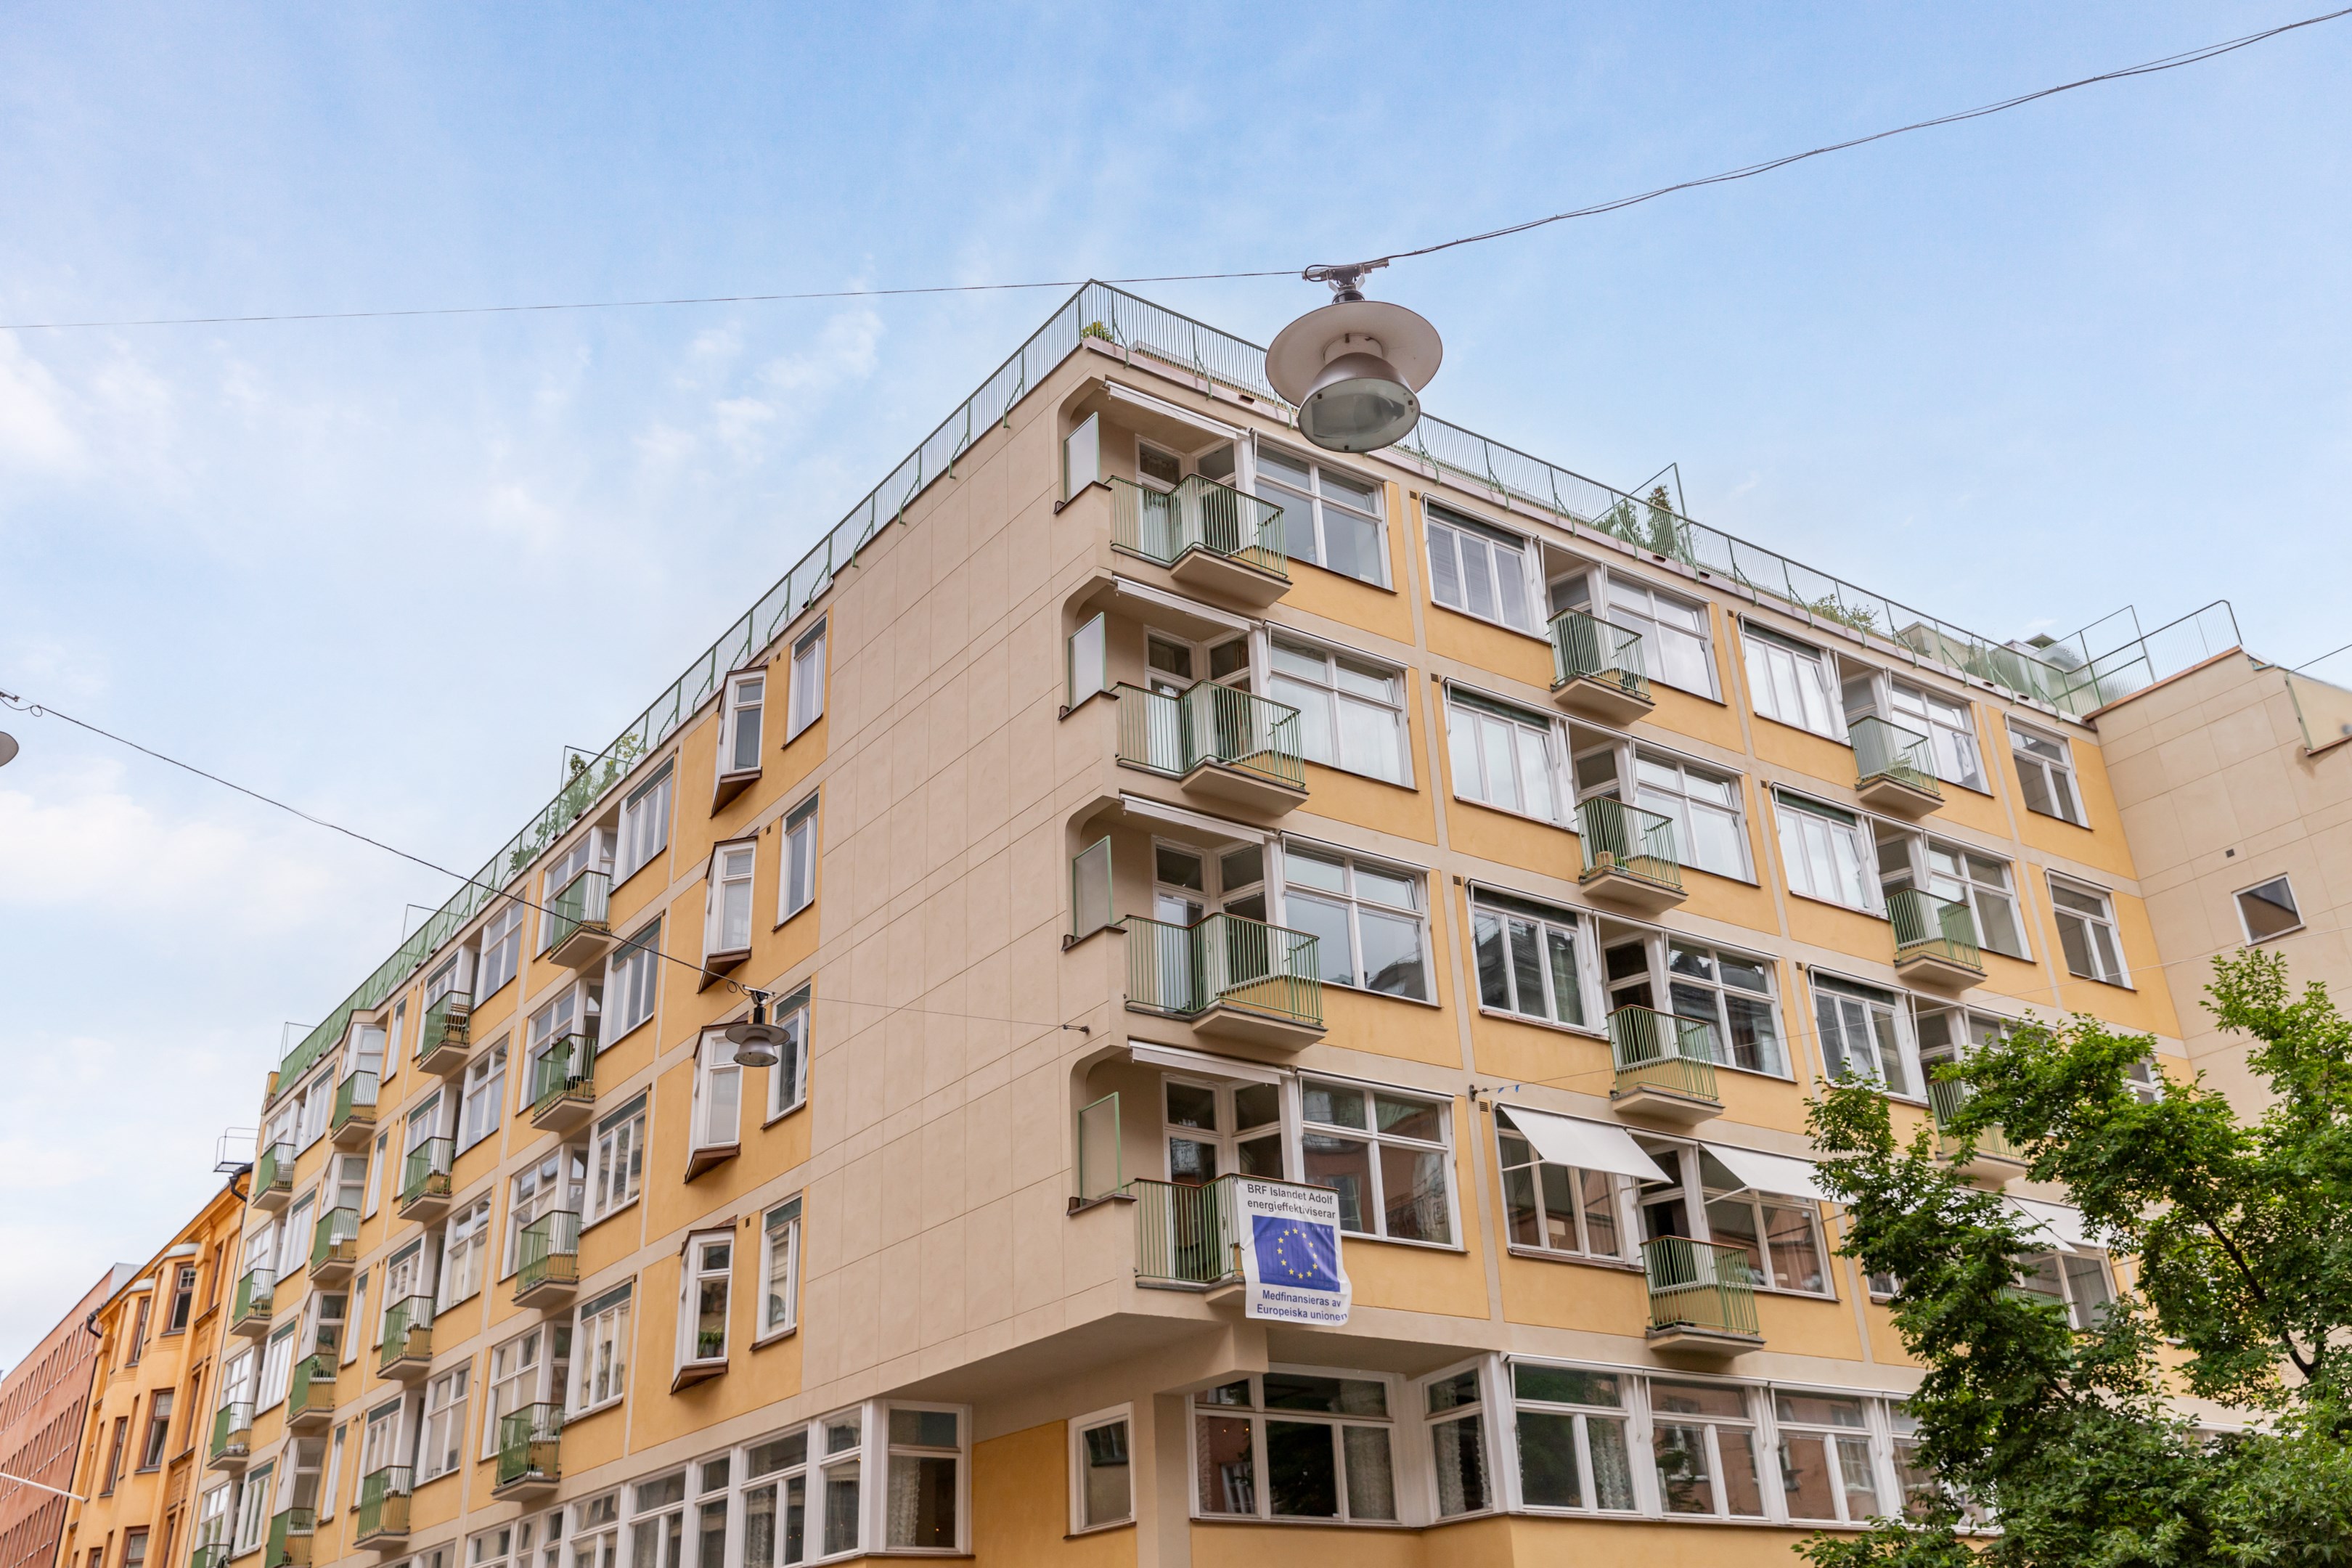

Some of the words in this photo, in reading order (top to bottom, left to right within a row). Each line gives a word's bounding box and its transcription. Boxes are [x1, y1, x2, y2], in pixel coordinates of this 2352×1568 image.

[1248, 1184, 1267, 1194] BRF
[1270, 1187, 1306, 1201] Islandet
[1309, 1193, 1333, 1204] Adolf
[1247, 1200, 1336, 1219] energieffektiviserar
[1262, 1290, 1329, 1306] Medfinansieras
[1332, 1298, 1342, 1307] av
[1257, 1304, 1308, 1318] Europeiska
[1310, 1312, 1347, 1320] unionen
